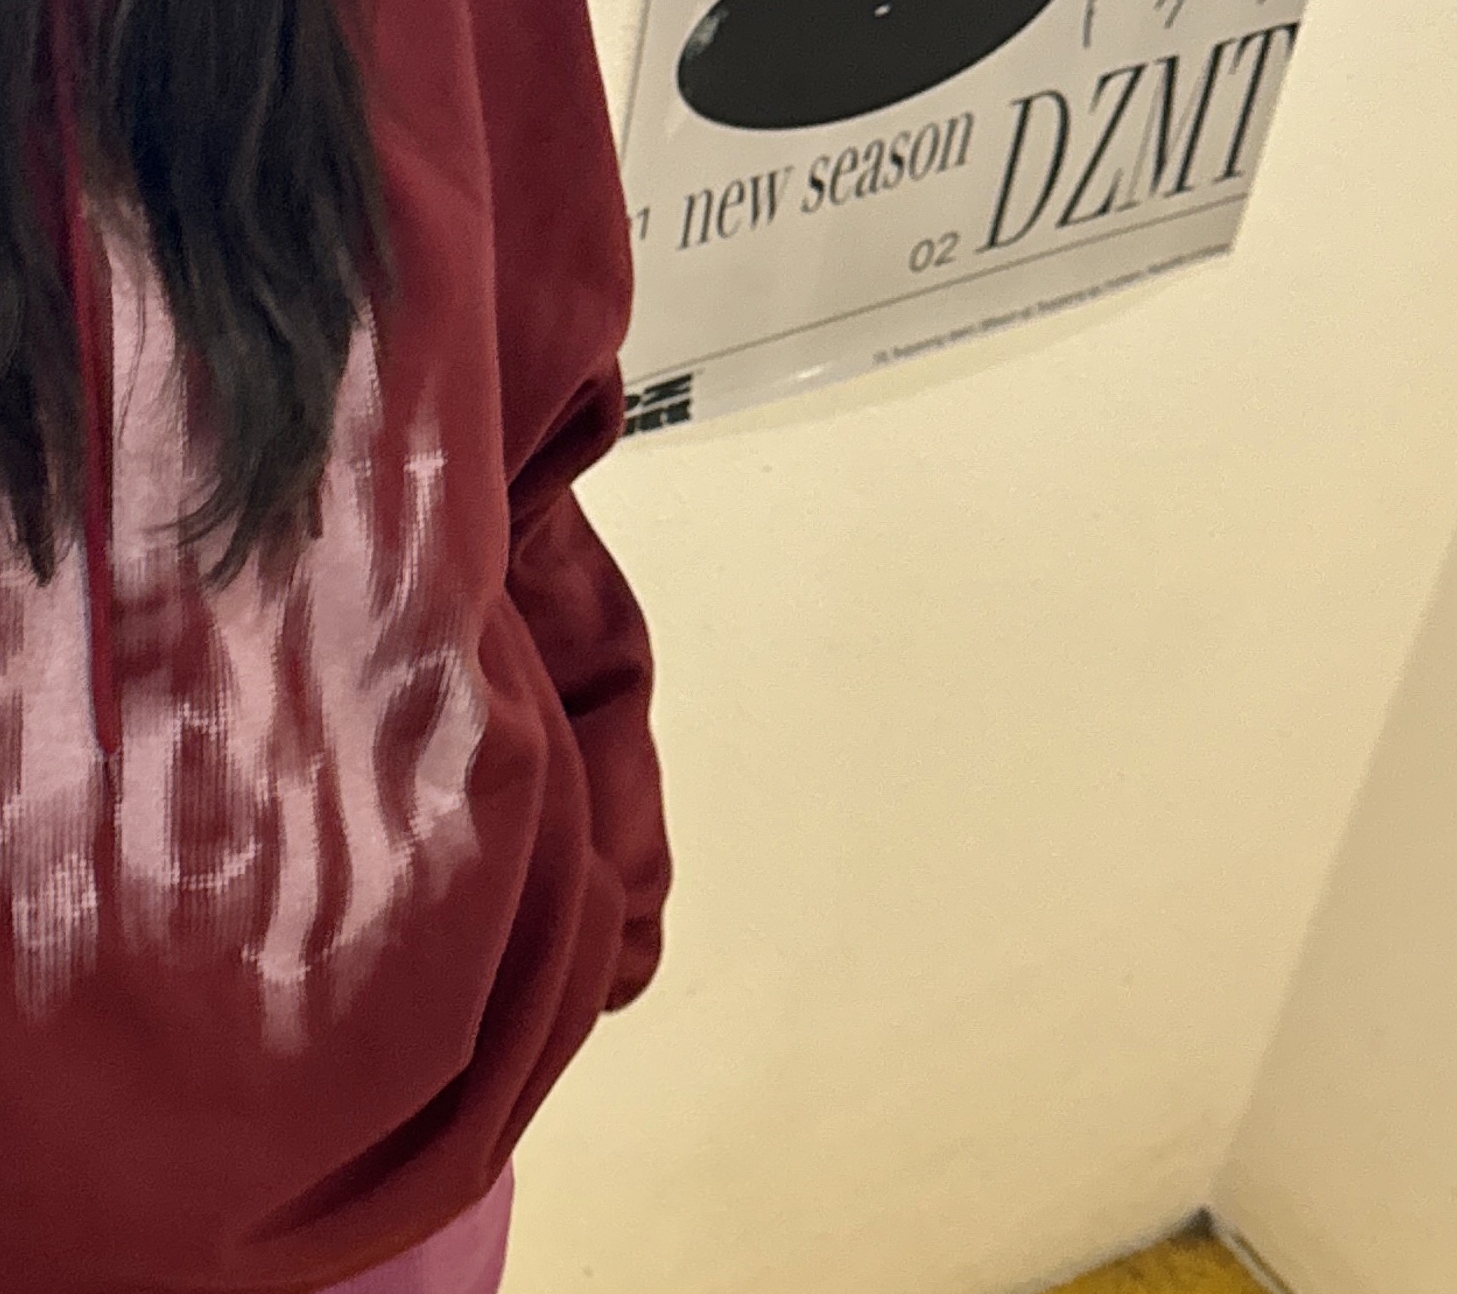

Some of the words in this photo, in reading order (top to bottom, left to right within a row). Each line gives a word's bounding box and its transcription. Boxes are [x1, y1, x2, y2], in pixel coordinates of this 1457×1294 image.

[675, 165, 795, 252] new
[800, 111, 975, 214] season
[908, 230, 961, 274] 02
[975, 21, 1300, 253] DZMT
